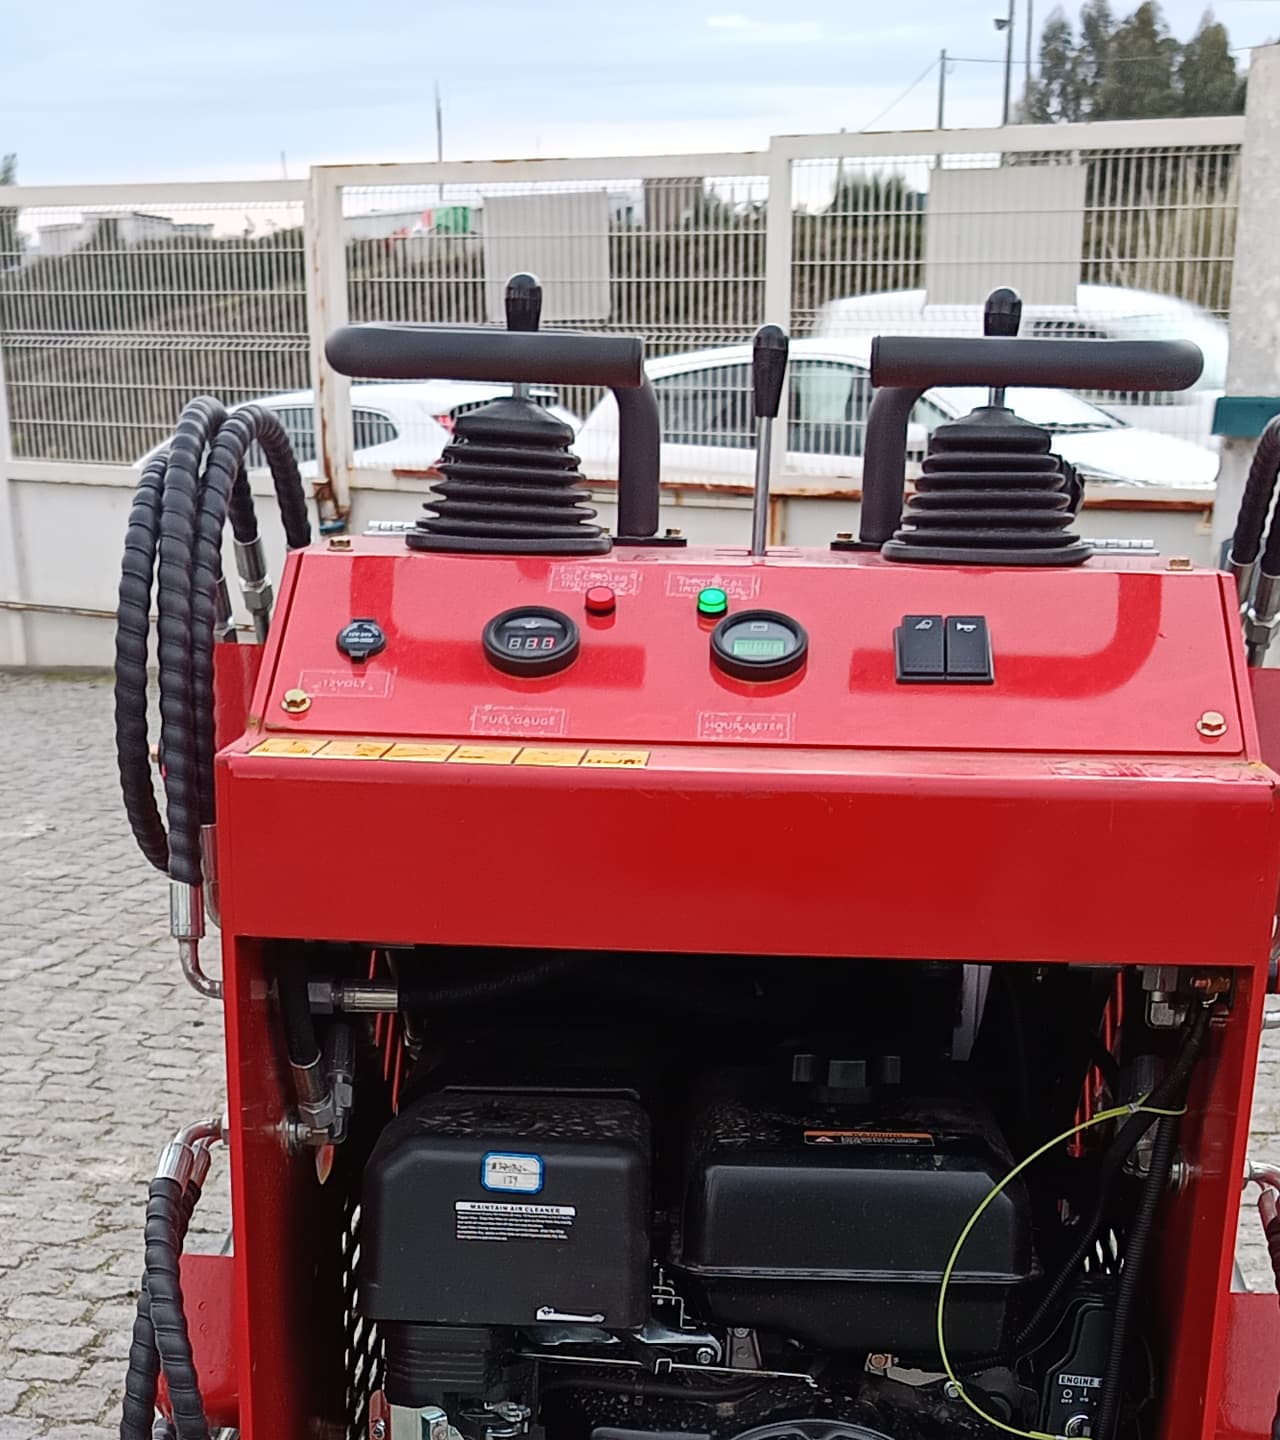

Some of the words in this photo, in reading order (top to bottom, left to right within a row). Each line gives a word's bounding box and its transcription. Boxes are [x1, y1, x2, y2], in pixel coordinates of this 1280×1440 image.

[705, 720, 740, 730] HOUR
[745, 722, 784, 731] METER
[470, 1204, 508, 1212] MAINTAIN
[1061, 1376, 1095, 1386] ENGINE
